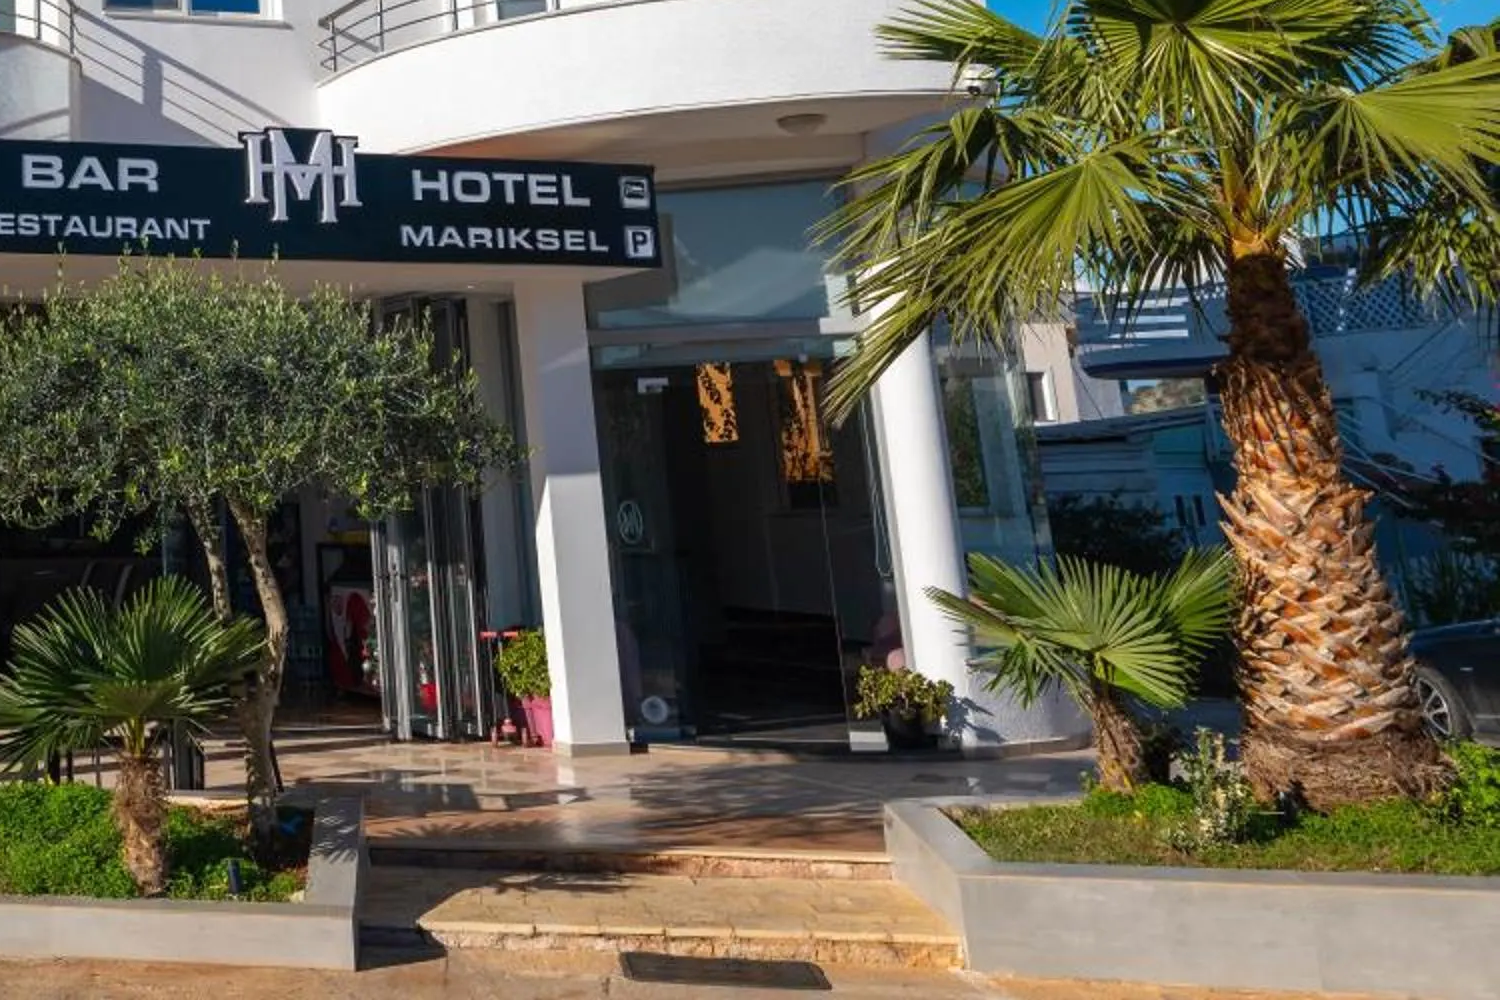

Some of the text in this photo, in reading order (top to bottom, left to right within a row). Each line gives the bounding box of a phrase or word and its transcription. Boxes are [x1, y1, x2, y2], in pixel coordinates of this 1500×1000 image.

[21, 153, 159, 193] BAR
[411, 169, 591, 208] HOTEL
[400, 225, 609, 252] MARIKSEL
